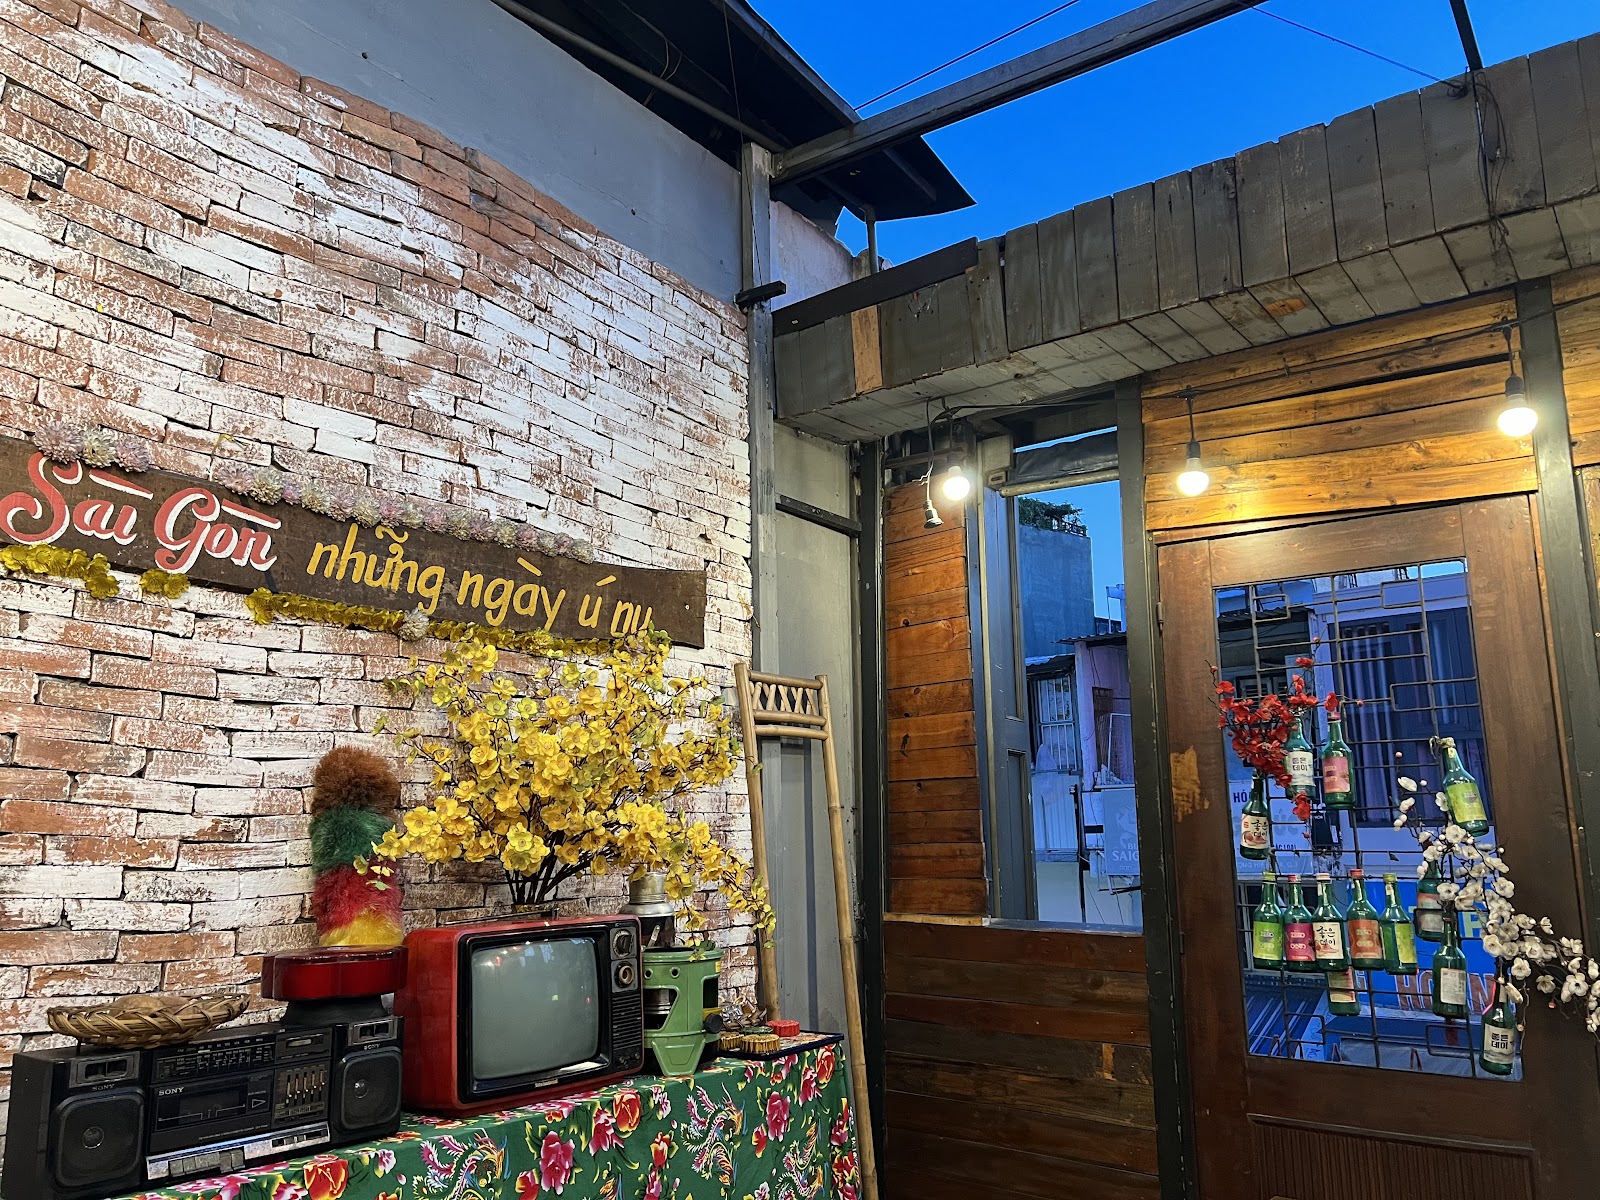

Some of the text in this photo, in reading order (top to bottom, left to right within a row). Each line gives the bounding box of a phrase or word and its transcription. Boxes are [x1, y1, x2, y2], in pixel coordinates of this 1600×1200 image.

[456, 557, 567, 631] ngày
[92, 1083, 115, 1092] SONY
[158, 1086, 185, 1096] SONY
